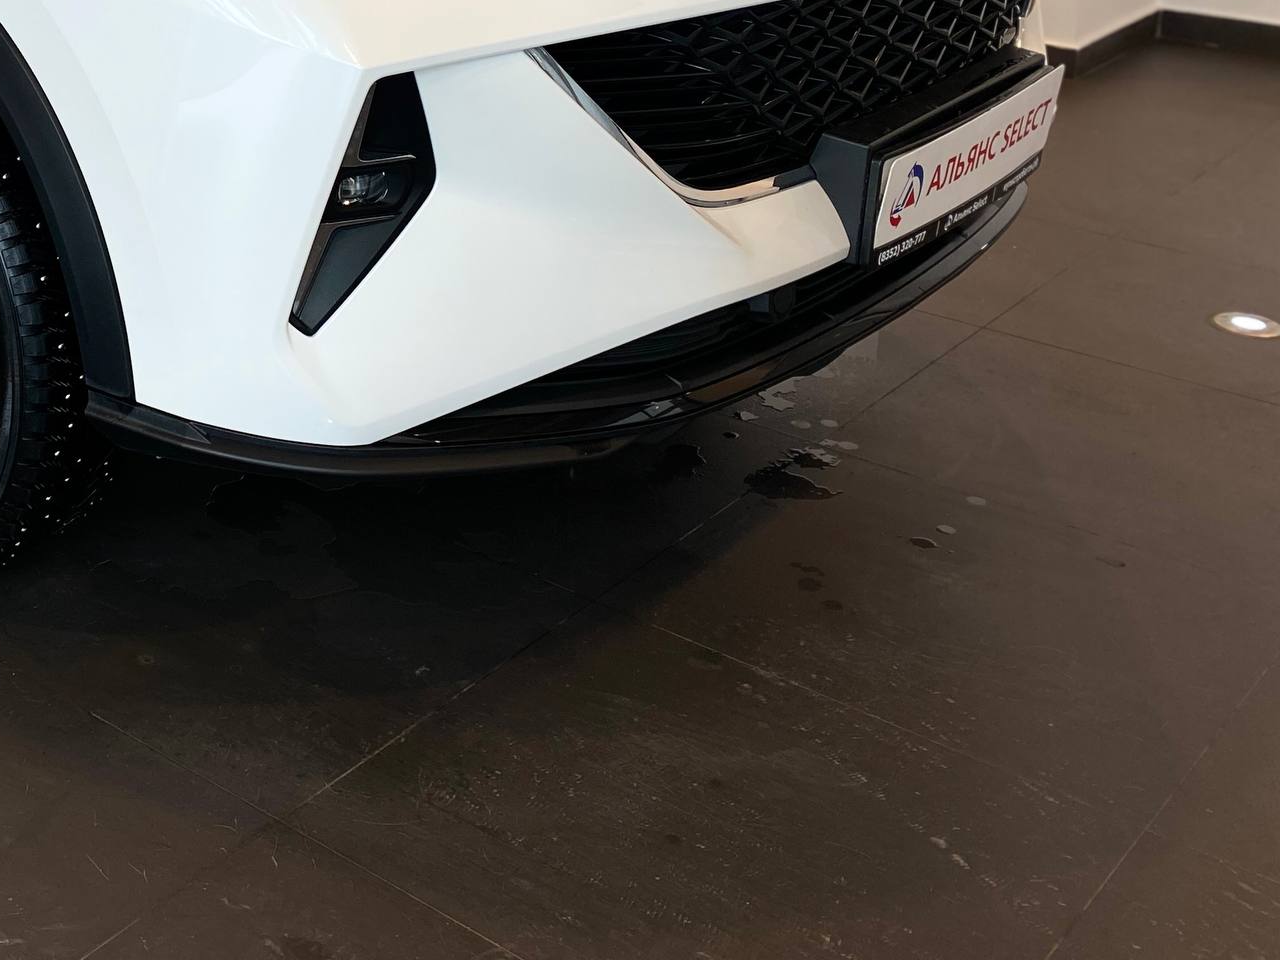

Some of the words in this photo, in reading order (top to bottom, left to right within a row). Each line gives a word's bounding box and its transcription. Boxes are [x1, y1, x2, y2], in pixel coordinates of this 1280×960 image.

[926, 131, 1001, 196] АЛЬЯНС
[1000, 98, 1052, 153] SELECT
[878, 244, 901, 266] (8352)
[900, 230, 927, 253] 320-777
